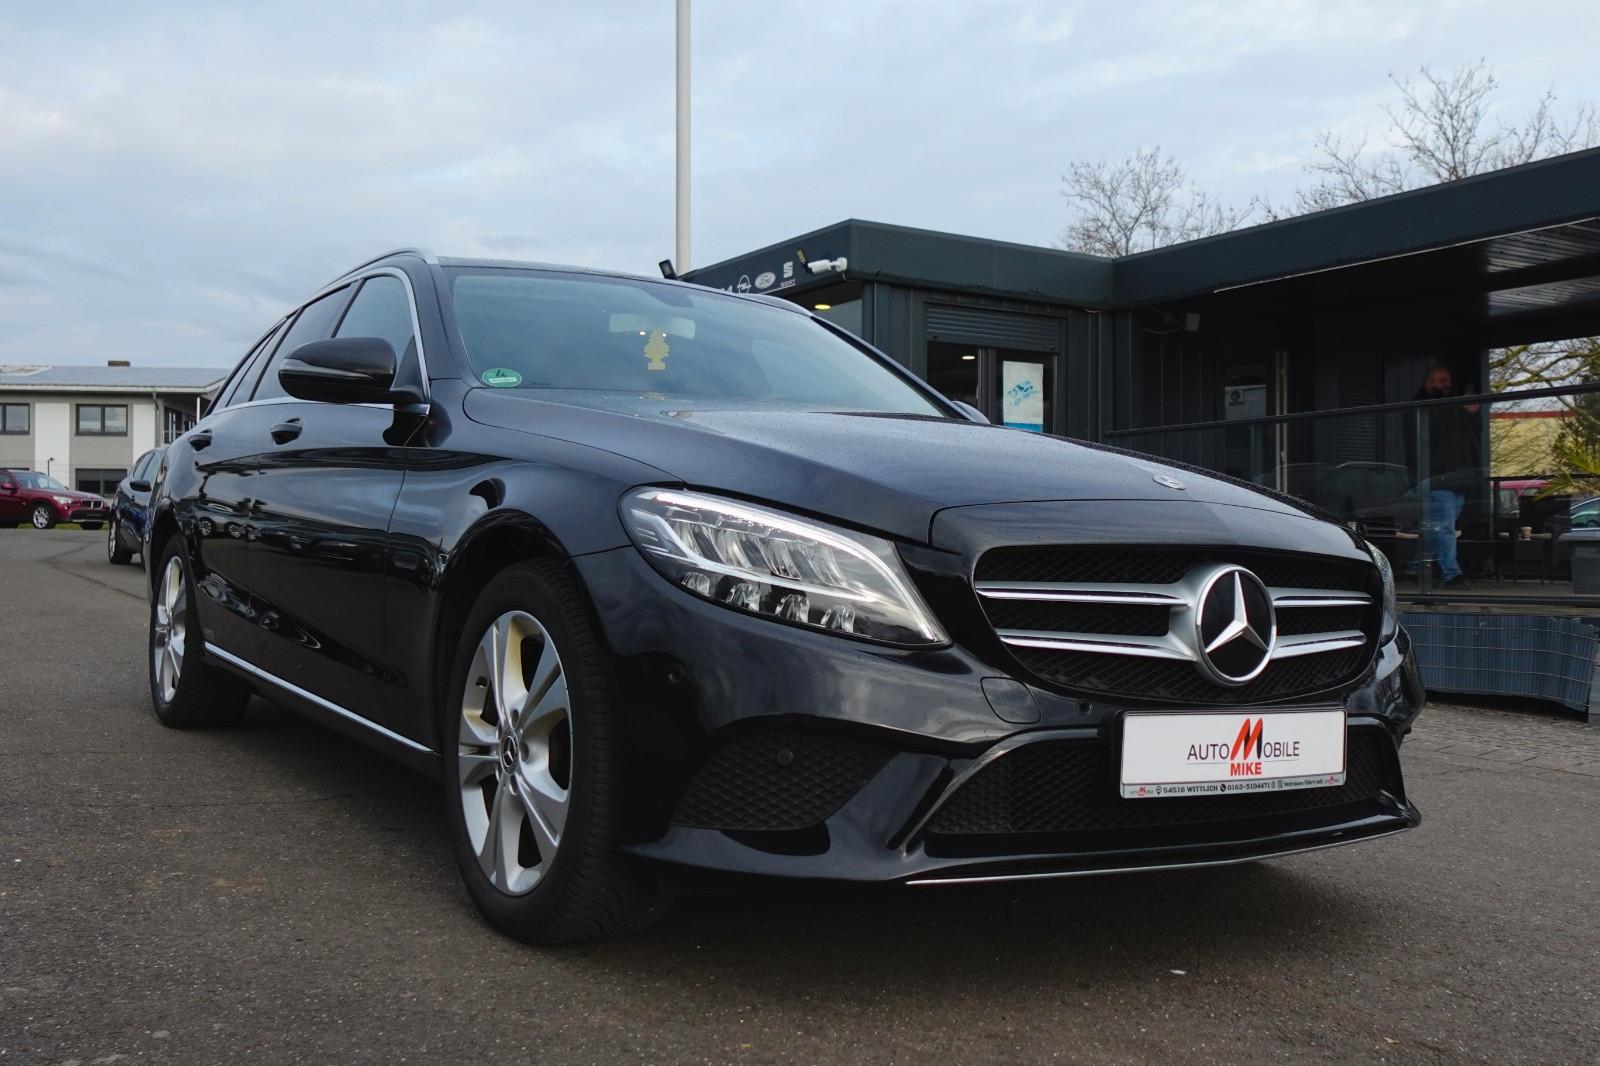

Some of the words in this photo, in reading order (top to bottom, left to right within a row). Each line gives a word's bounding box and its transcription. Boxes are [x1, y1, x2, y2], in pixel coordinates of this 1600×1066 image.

[1230, 762, 1262, 776] MIKE
[1163, 786, 1186, 794] 54516
[1187, 784, 1218, 793] WITTLICH
